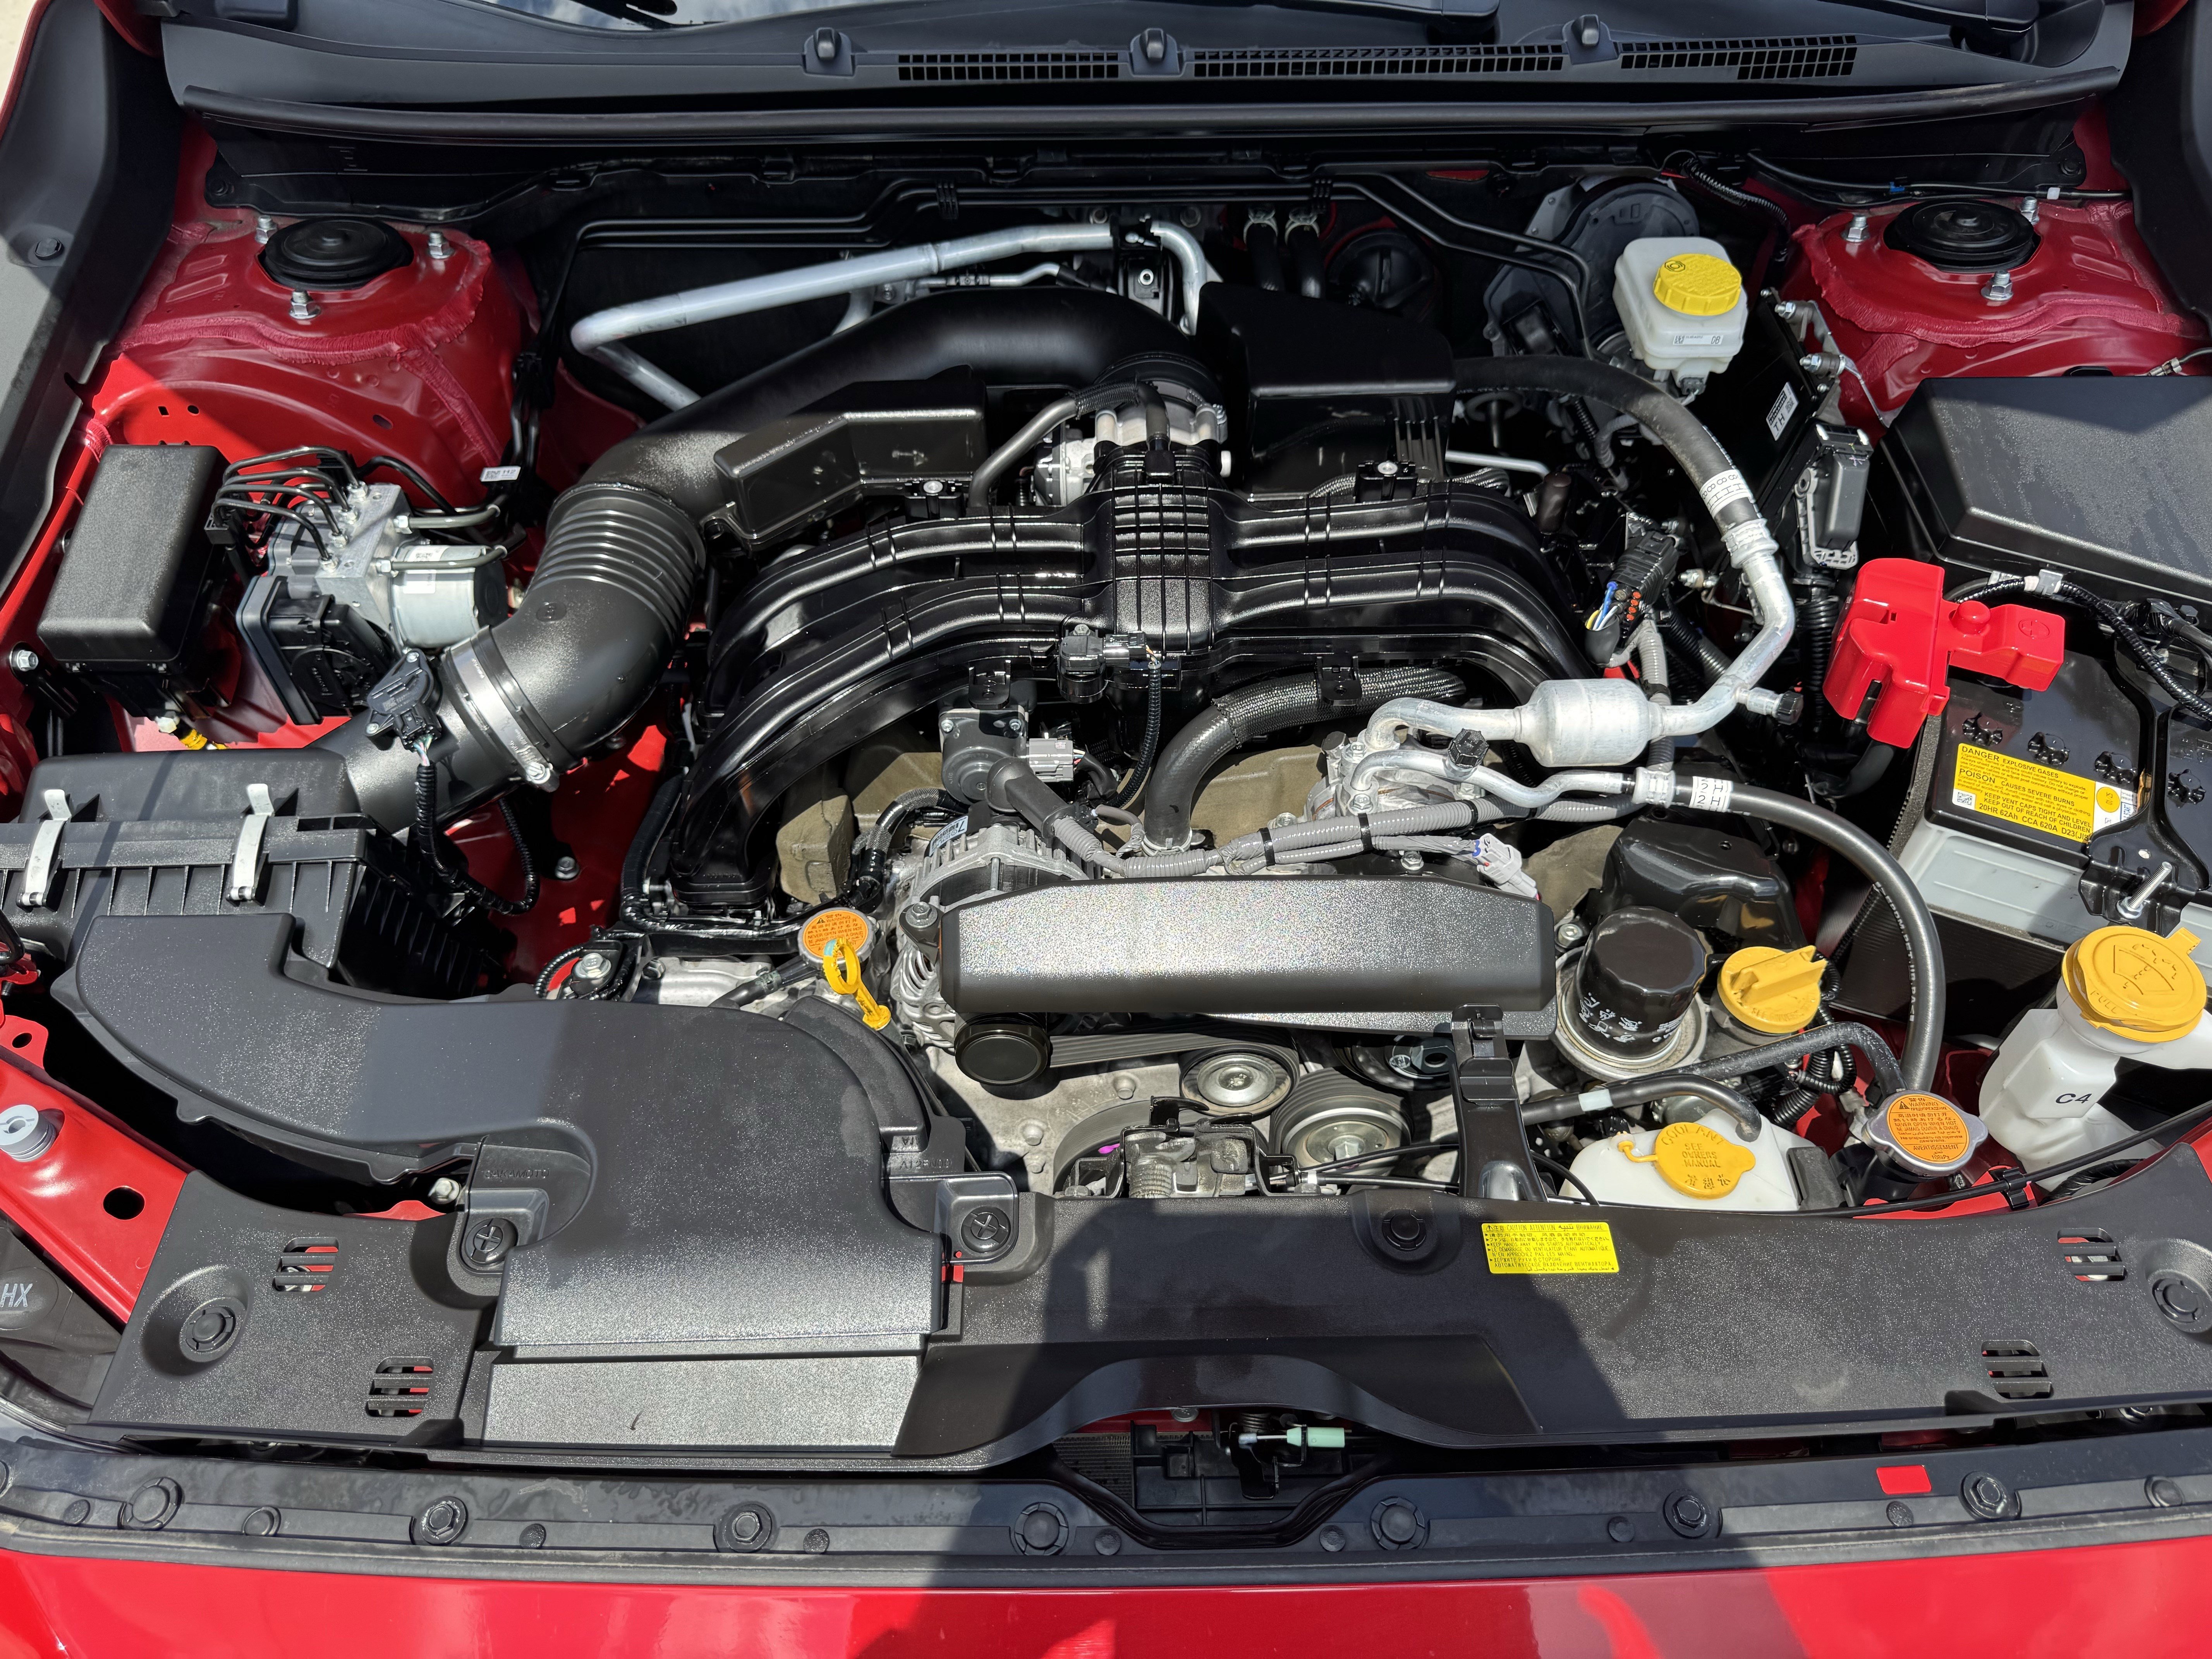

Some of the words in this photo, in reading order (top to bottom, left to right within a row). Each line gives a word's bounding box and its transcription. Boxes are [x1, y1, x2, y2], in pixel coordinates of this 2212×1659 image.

[1711, 336, 1721, 344] DB
[1962, 745, 1999, 762] DANGER
[2002, 758, 2036, 772] EXPLOSIVE
[2037, 768, 2059, 778] GASES
[1959, 768, 1995, 784] POISON
[2001, 781, 2026, 792] CAUSES
[2027, 788, 2051, 799] SEVERE
[2053, 796, 2075, 806] BURNS
[1979, 803, 1998, 814] 20HR
[1999, 809, 2018, 820] 62Ah
[2022, 815, 2038, 826] CCA
[2040, 821, 2057, 832] 620A
[1984, 792, 2001, 801] KEEP
[2002, 797, 2018, 805] VENT
[2019, 802, 2036, 811] CAPS
[2038, 807, 2056, 817] TIGHT
[2057, 813, 2070, 821] AND
[2072, 817, 2092, 828] LEVEL
[1984, 797, 2000, 806] KEEP
[2001, 802, 2014, 811] OUT
[2026, 809, 2047, 820] REACH
[2059, 819, 2090, 833] CHILDREN
[2056, 1093, 2092, 1103] C4
[1661, 1124, 1726, 1145] COOLANT
[1685, 1143, 1703, 1151] SEE
[485, 1169, 550, 1178] SAKAMOTO
[1684, 1159, 1721, 1168] MANUAL
